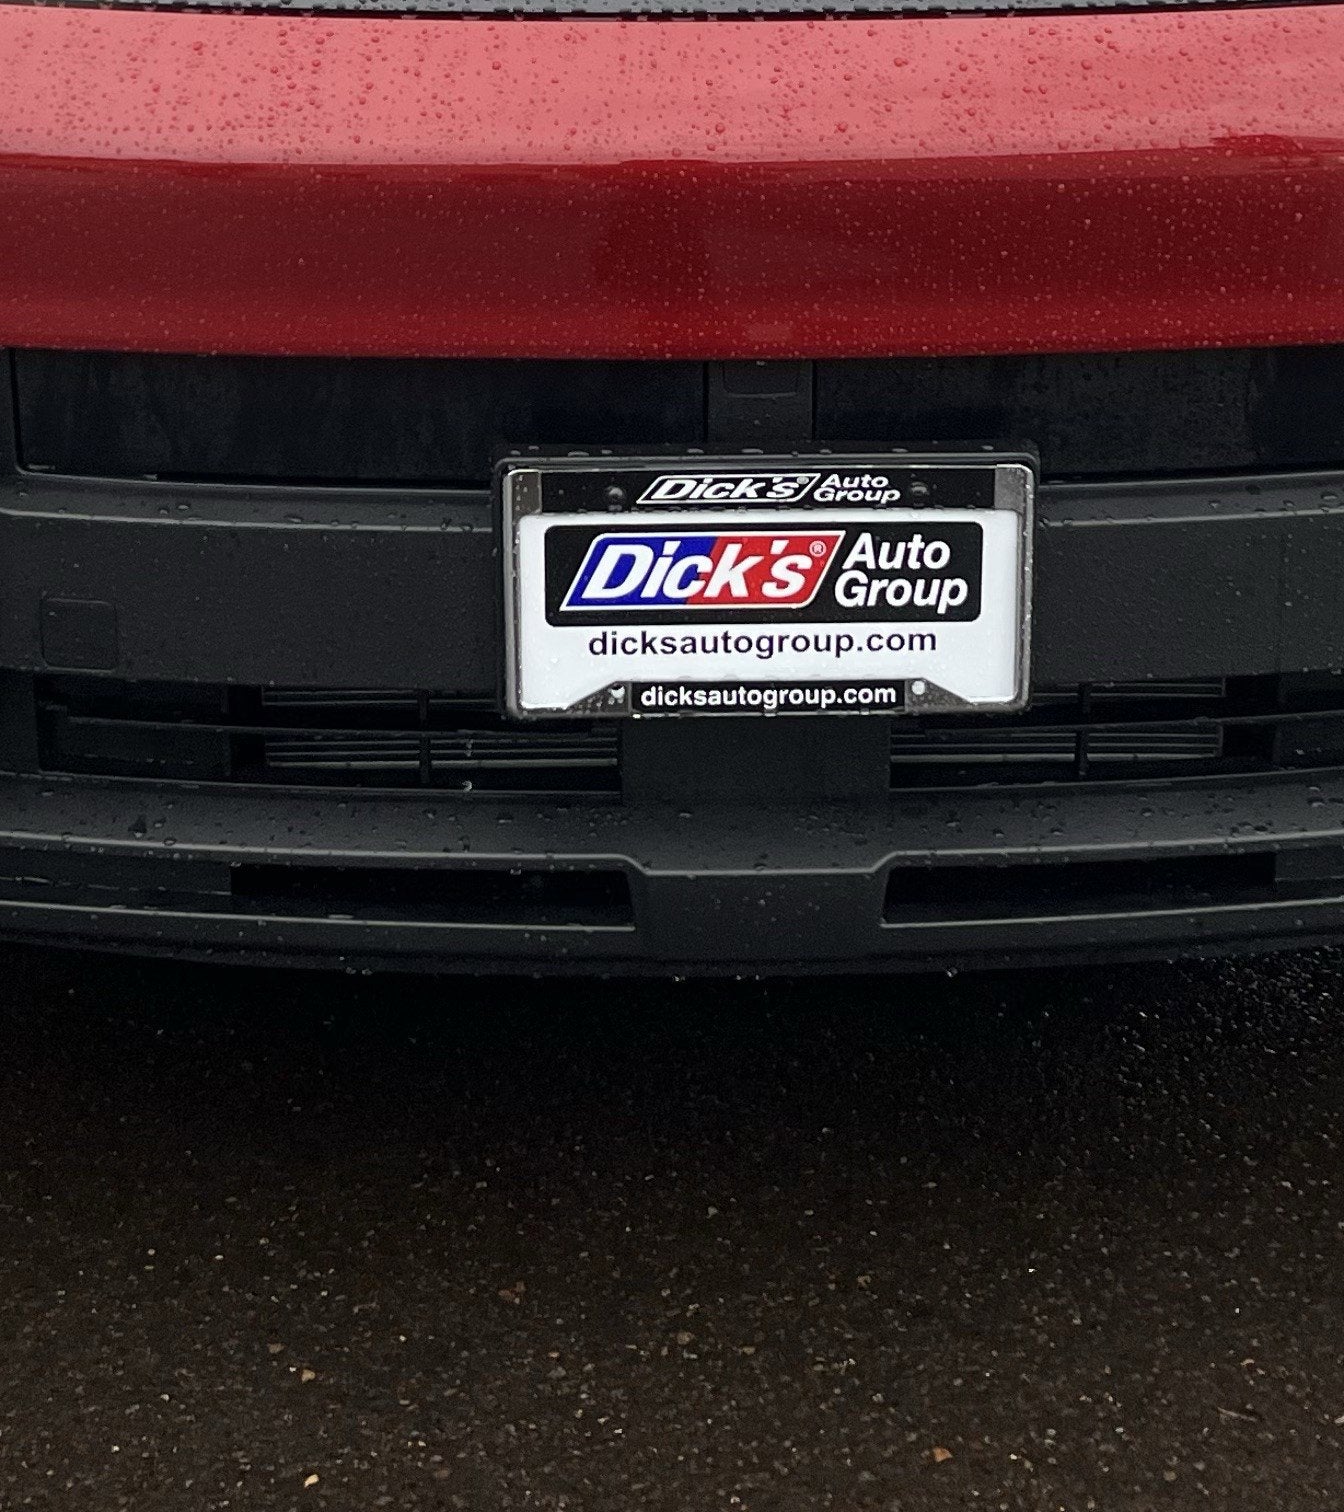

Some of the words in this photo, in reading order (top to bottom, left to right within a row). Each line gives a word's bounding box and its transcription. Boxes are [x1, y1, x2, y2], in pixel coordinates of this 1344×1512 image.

[823, 473, 889, 489] Auto
[813, 487, 901, 505] Group
[842, 532, 951, 570] Auto
[834, 576, 969, 615] Group
[588, 630, 937, 659] dicksautogroup.com
[640, 683, 897, 712] dicksautogroup.com
